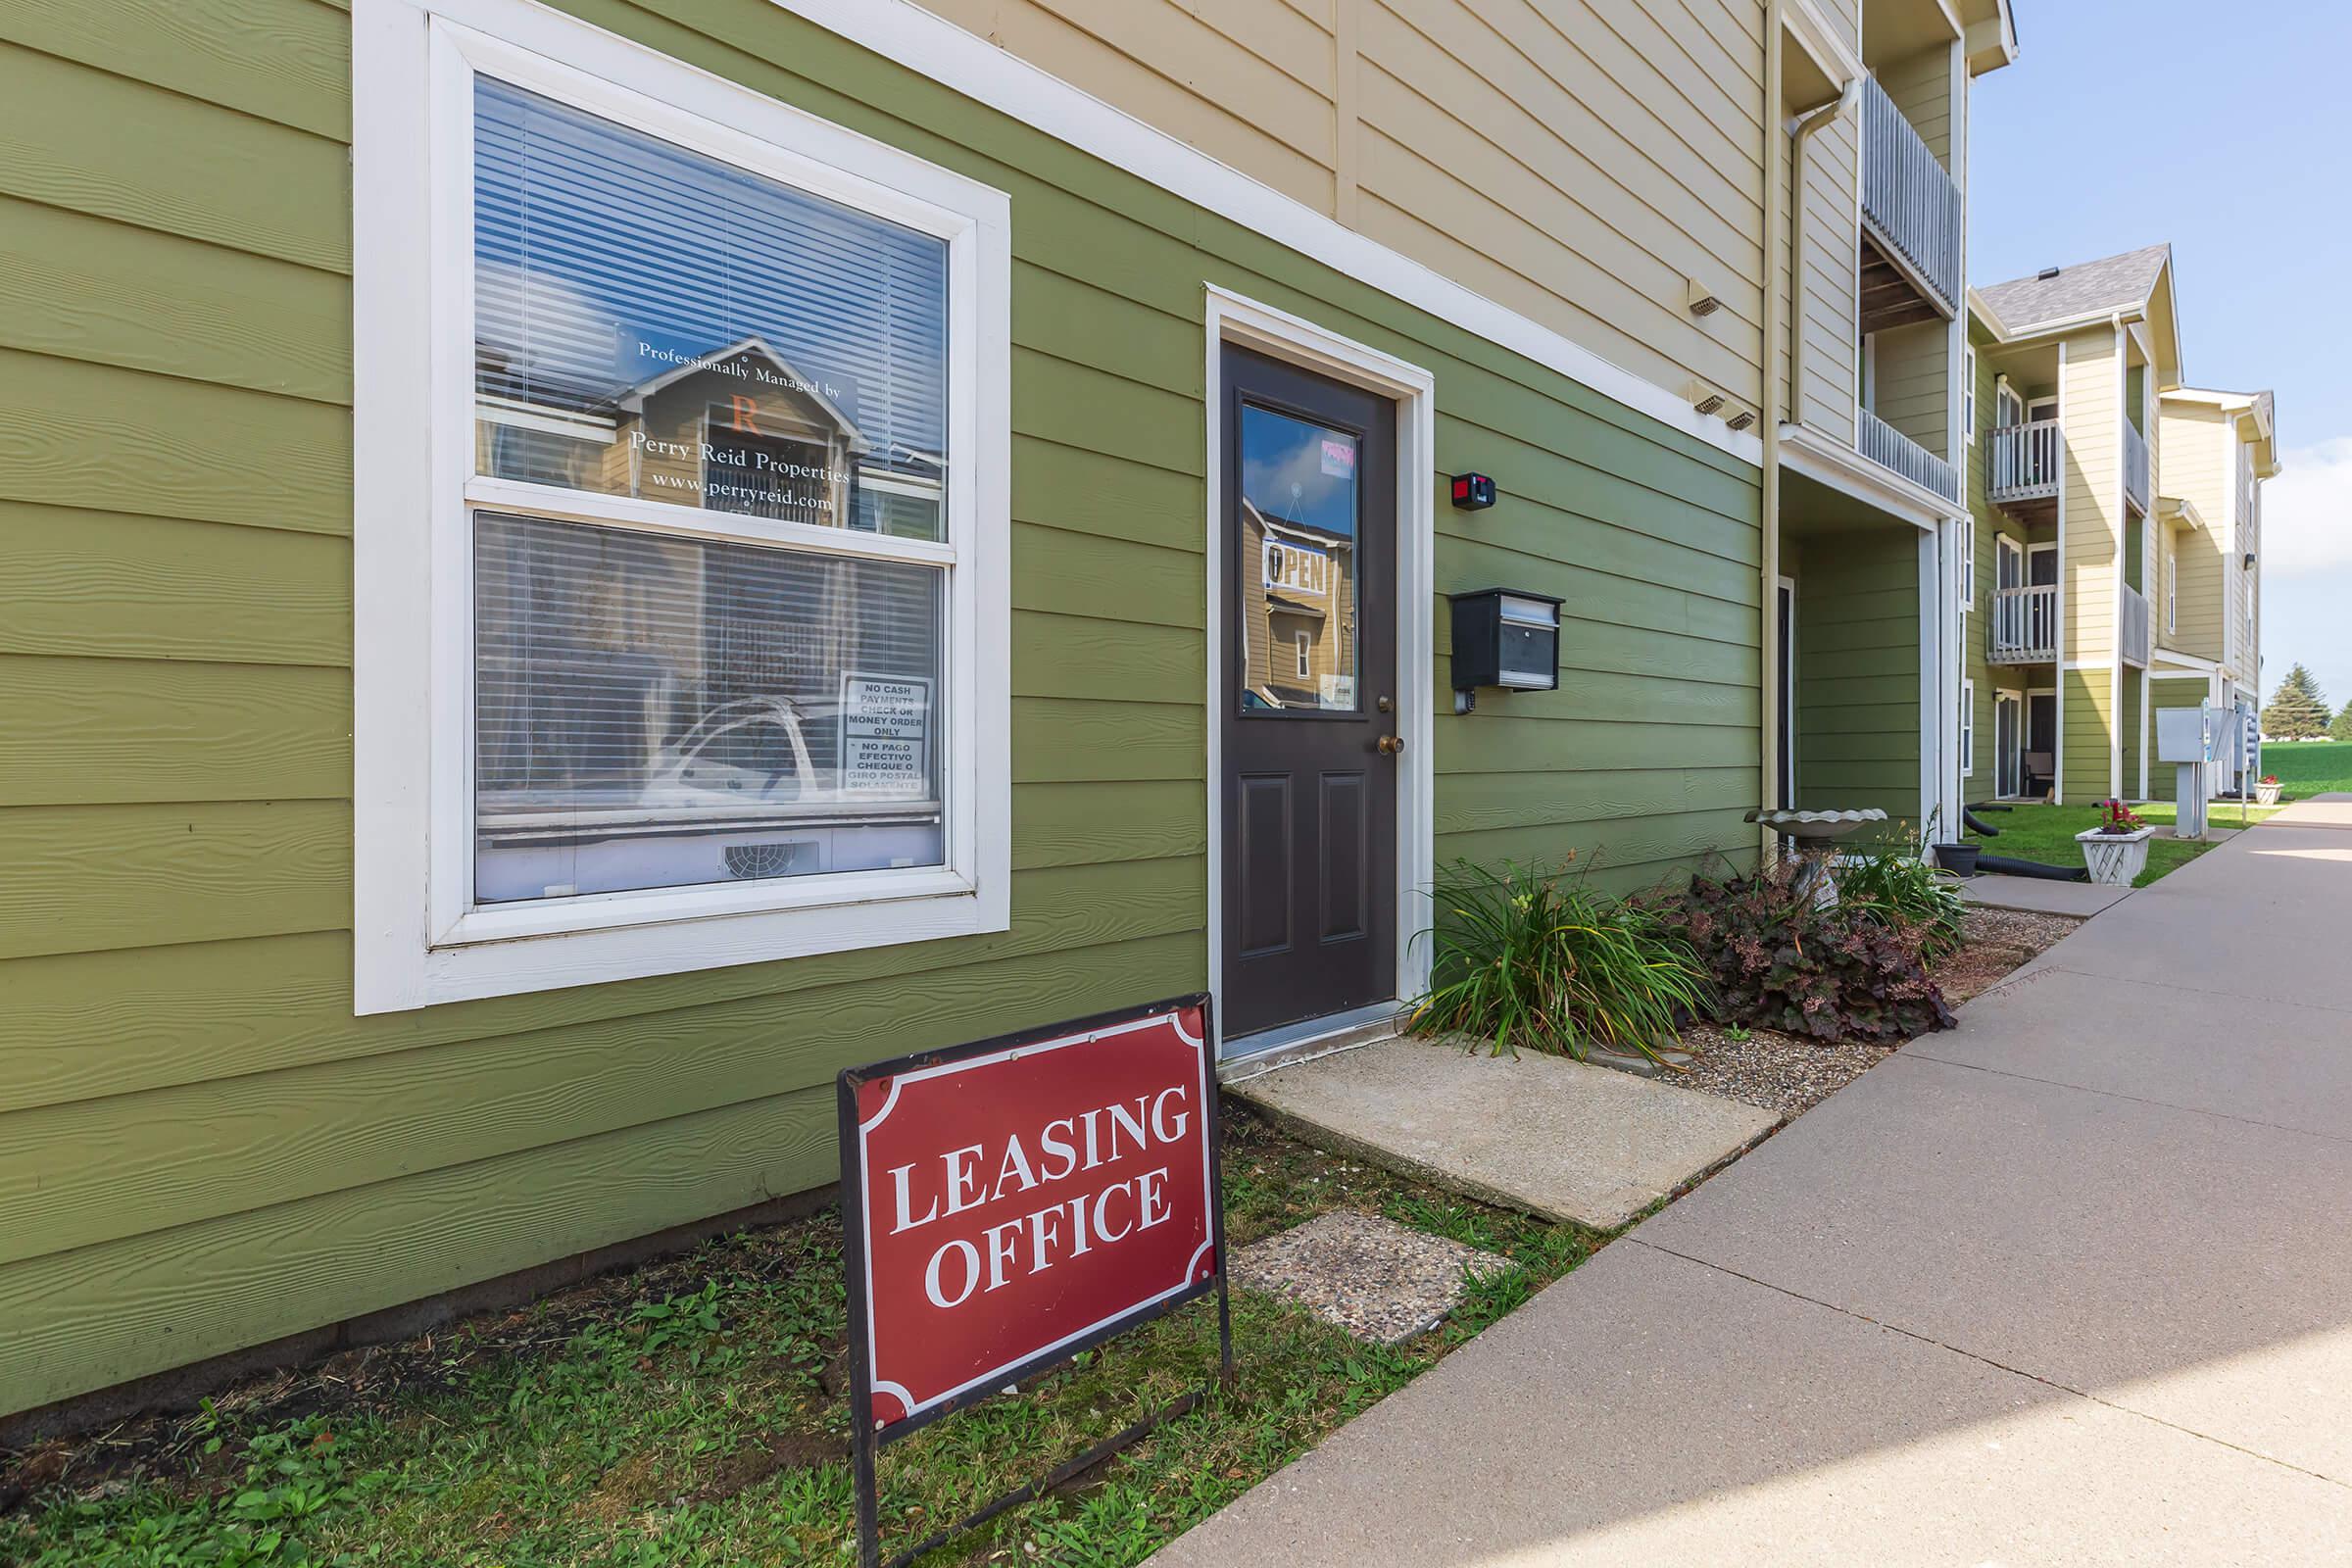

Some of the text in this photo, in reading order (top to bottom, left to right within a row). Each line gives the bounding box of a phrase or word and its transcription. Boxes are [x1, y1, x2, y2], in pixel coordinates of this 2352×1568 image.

[639, 342, 840, 400] Professionally Managed by
[730, 394, 762, 437] R
[630, 431, 849, 483] Perry Reid Properties
[653, 474, 832, 511] www.perryreid.com
[1268, 545, 1324, 592] OPEN
[860, 695, 914, 705] PAYMENTS
[887, 1085, 1190, 1236] LEASING
[924, 1166, 1171, 1308] OFFICE
